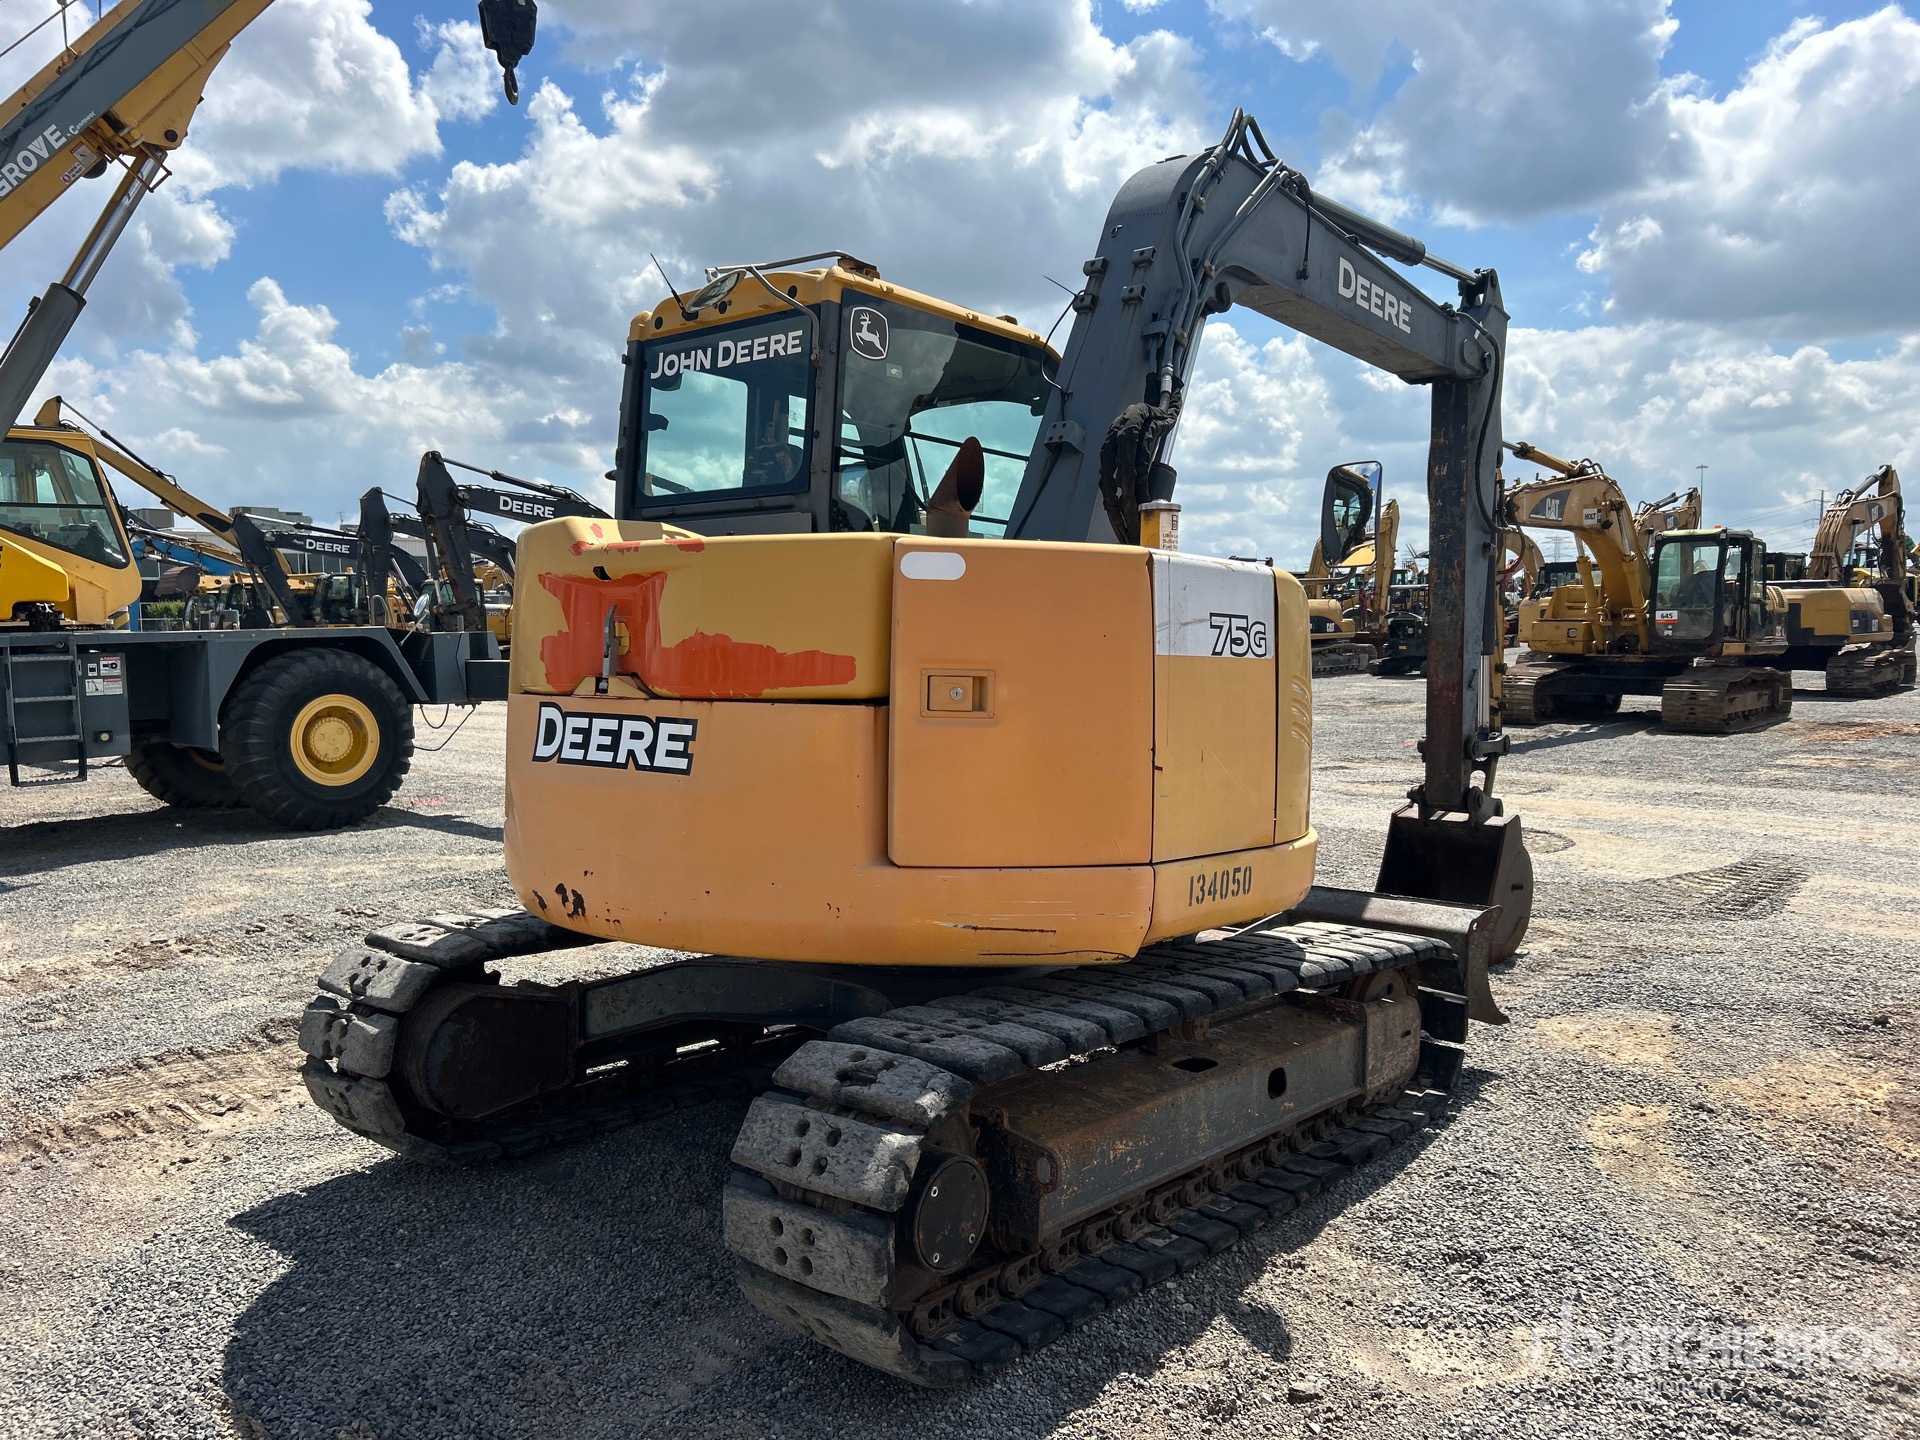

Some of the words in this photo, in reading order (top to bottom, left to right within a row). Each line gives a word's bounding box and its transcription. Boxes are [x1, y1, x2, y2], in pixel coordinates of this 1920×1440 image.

[0, 124, 67, 197] GROVE
[1338, 256, 1412, 334] DEERE
[651, 347, 712, 380] JOHN
[717, 329, 803, 368] DEERE
[499, 495, 555, 519] DEERE
[1545, 497, 1560, 521] CAT
[1584, 512, 1597, 520] HOLT
[305, 539, 350, 554] DEERE
[1209, 612, 1267, 658] 75G
[533, 703, 697, 774] DEERE
[1188, 865, 1252, 908] 134050
